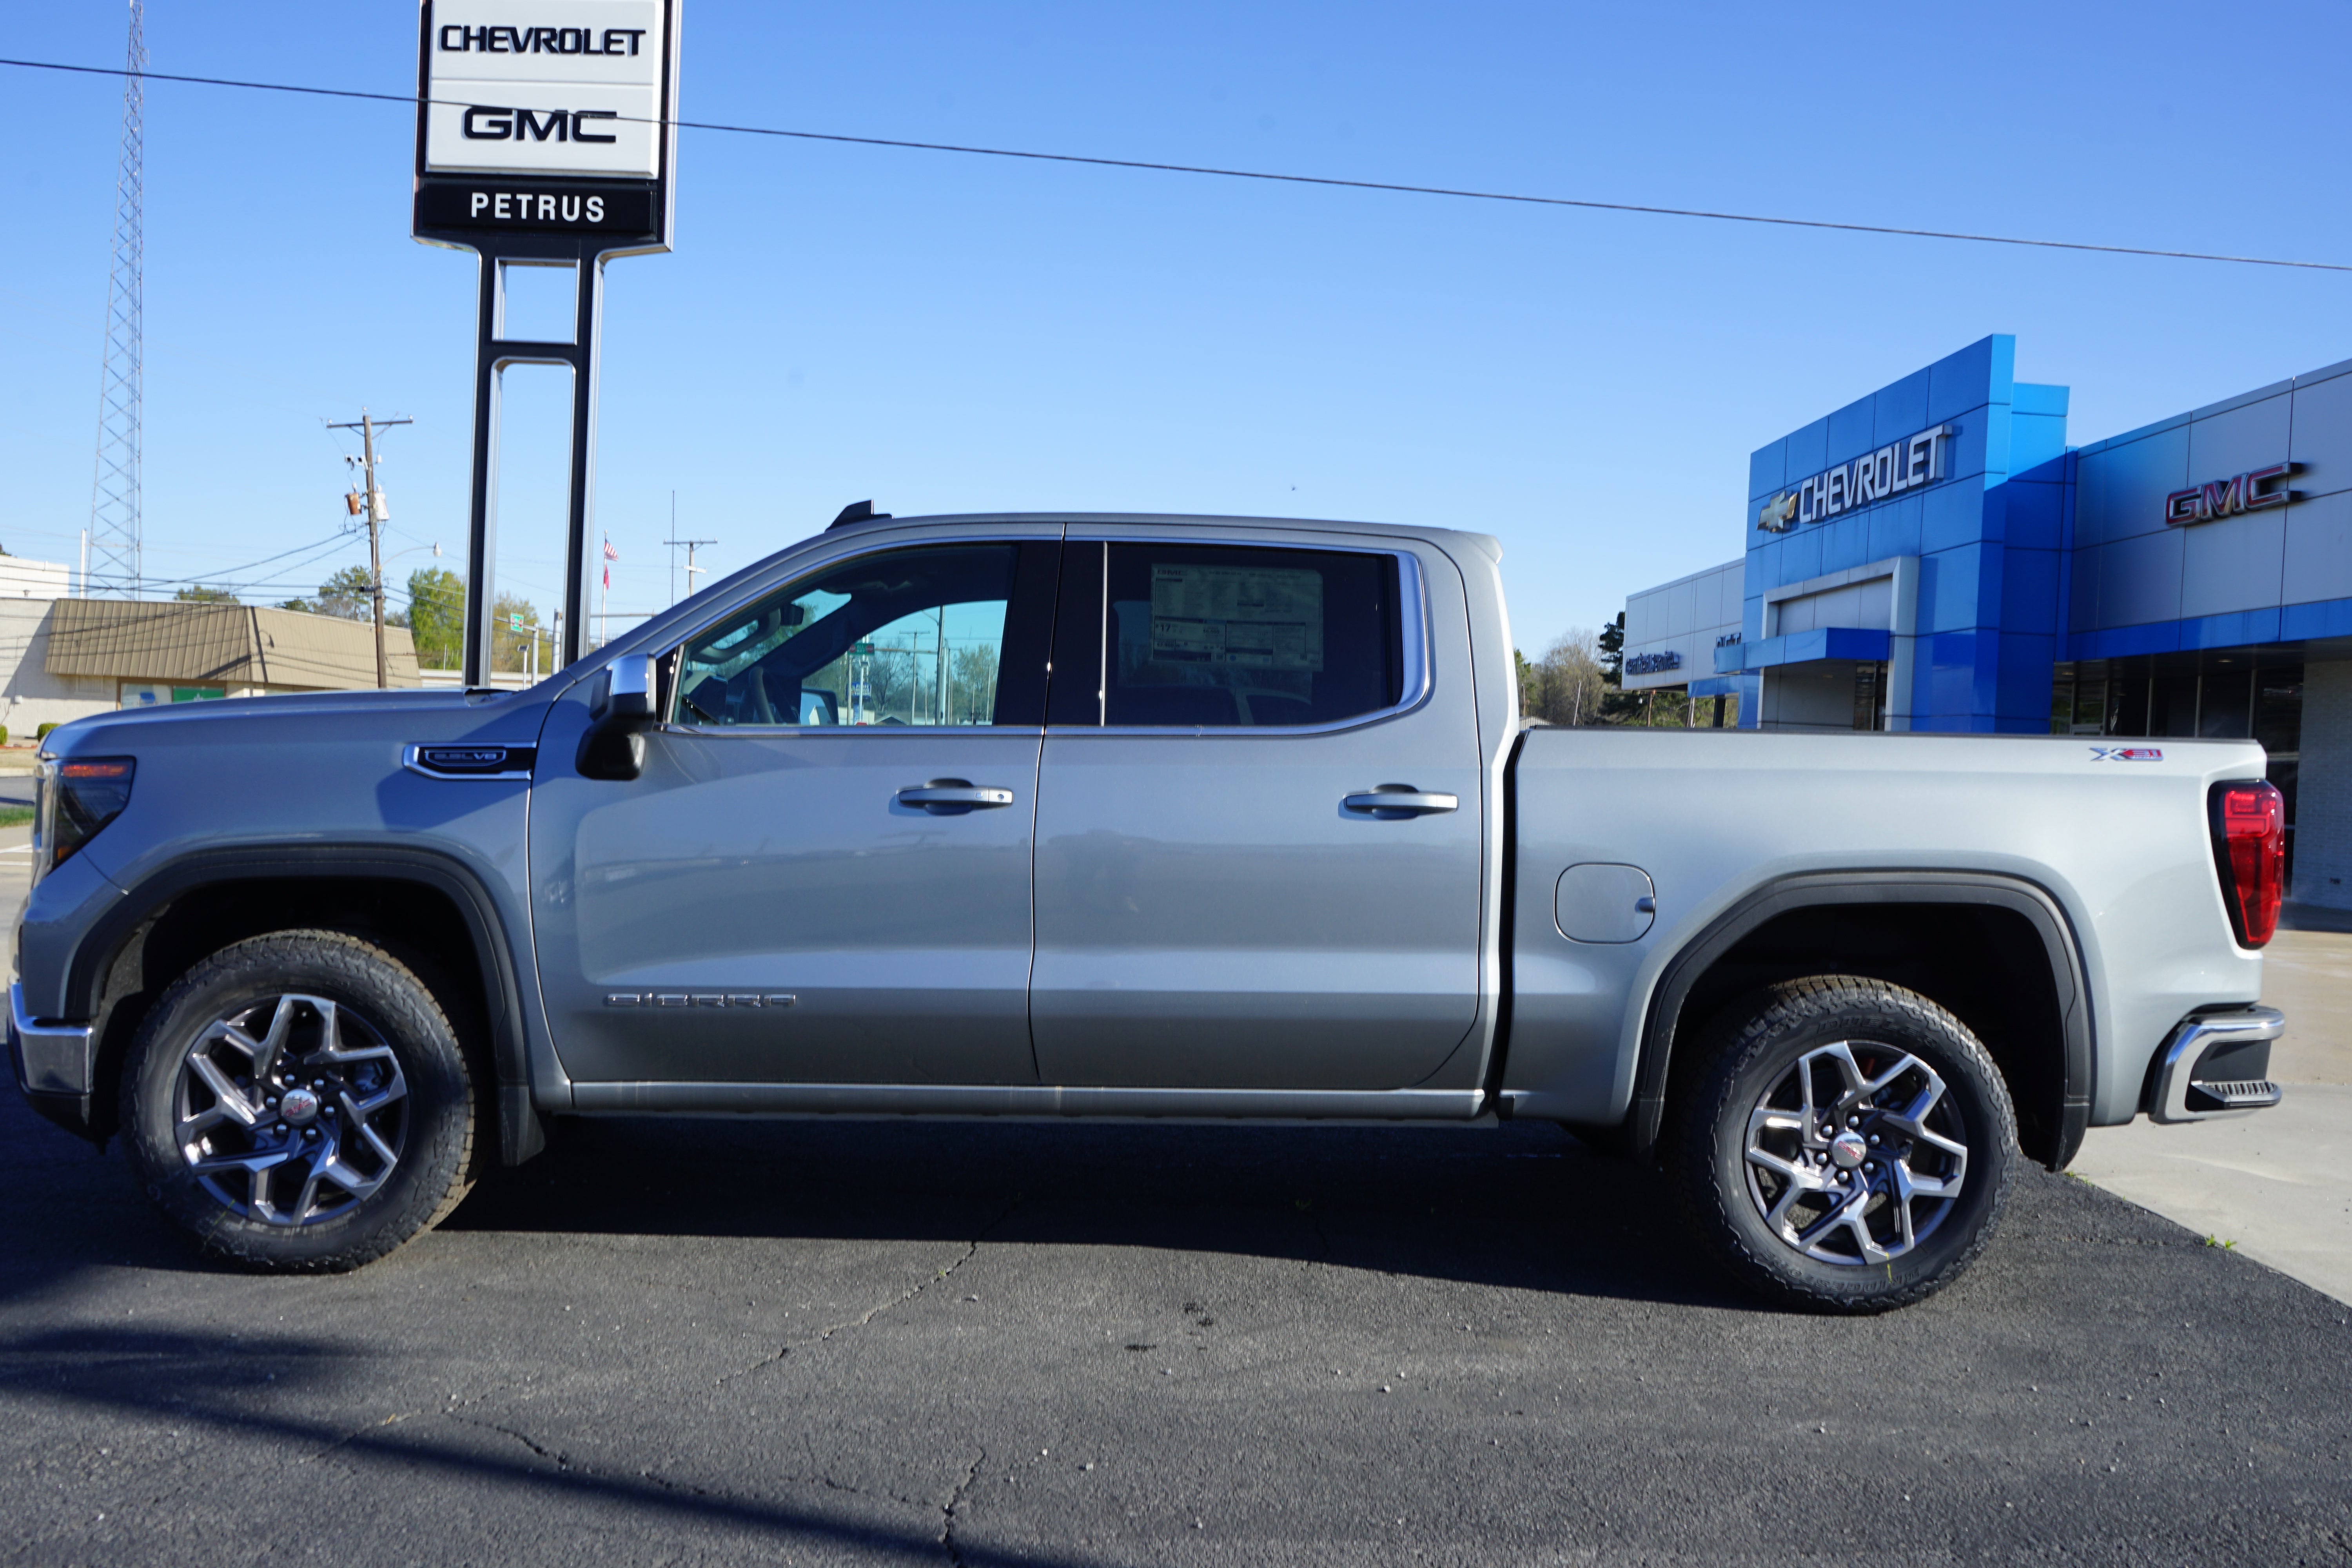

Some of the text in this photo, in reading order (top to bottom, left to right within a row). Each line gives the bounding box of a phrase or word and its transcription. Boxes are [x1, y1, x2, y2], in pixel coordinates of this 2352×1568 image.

[440, 25, 646, 56] CHEVROLET
[464, 105, 617, 143] GMC
[471, 192, 604, 223] PETRUS
[1799, 425, 1953, 524] CHEVROLET
[2164, 462, 2293, 528] GMC
[606, 993, 797, 1007] SIERRA
[285, 1098, 312, 1116] GMC
[1837, 1140, 1862, 1161] GMC
